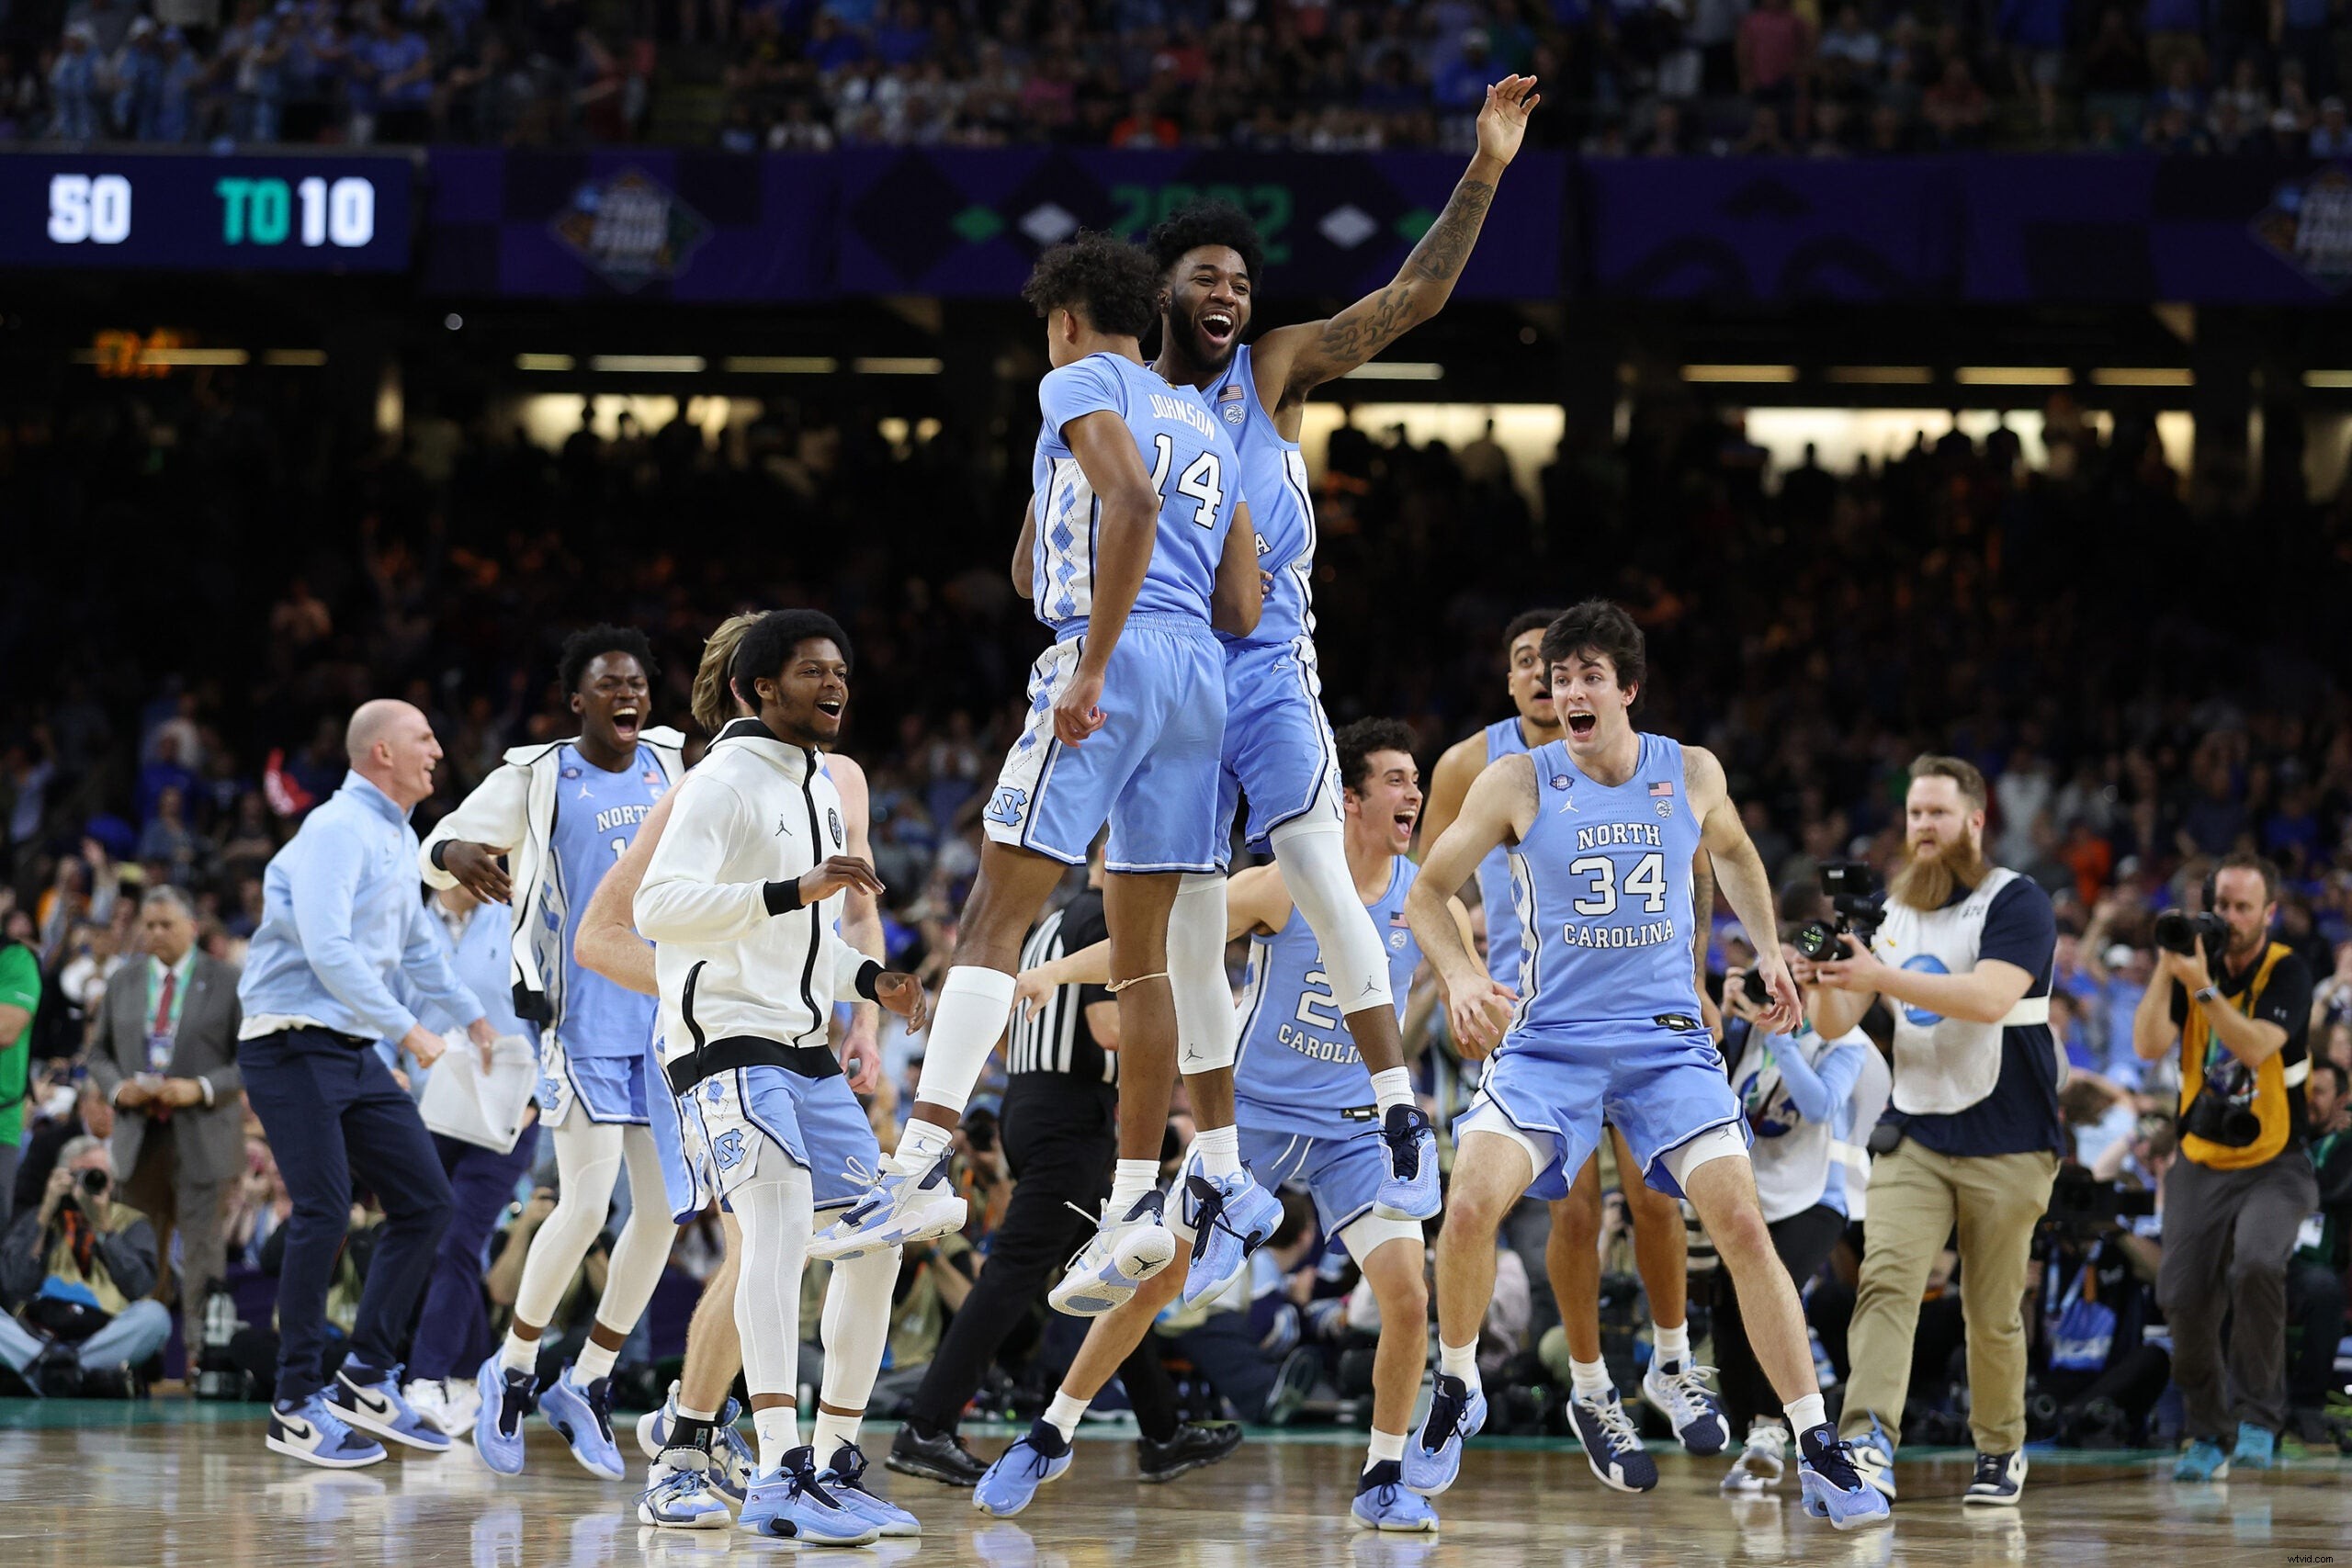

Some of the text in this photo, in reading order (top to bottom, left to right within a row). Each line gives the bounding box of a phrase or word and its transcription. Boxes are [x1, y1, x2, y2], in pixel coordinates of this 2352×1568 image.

[214, 176, 375, 247] TO 10
[1149, 393, 1216, 441] JOHNSON
[1151, 433, 1223, 530] 14
[596, 805, 655, 834] NORT
[1577, 823, 1662, 852] NORTH
[1569, 852, 1667, 917] 34
[1563, 918, 1675, 949] CAROLINA
[1295, 969, 1351, 1033] 2
[1278, 1023, 1364, 1066] CAROLI
